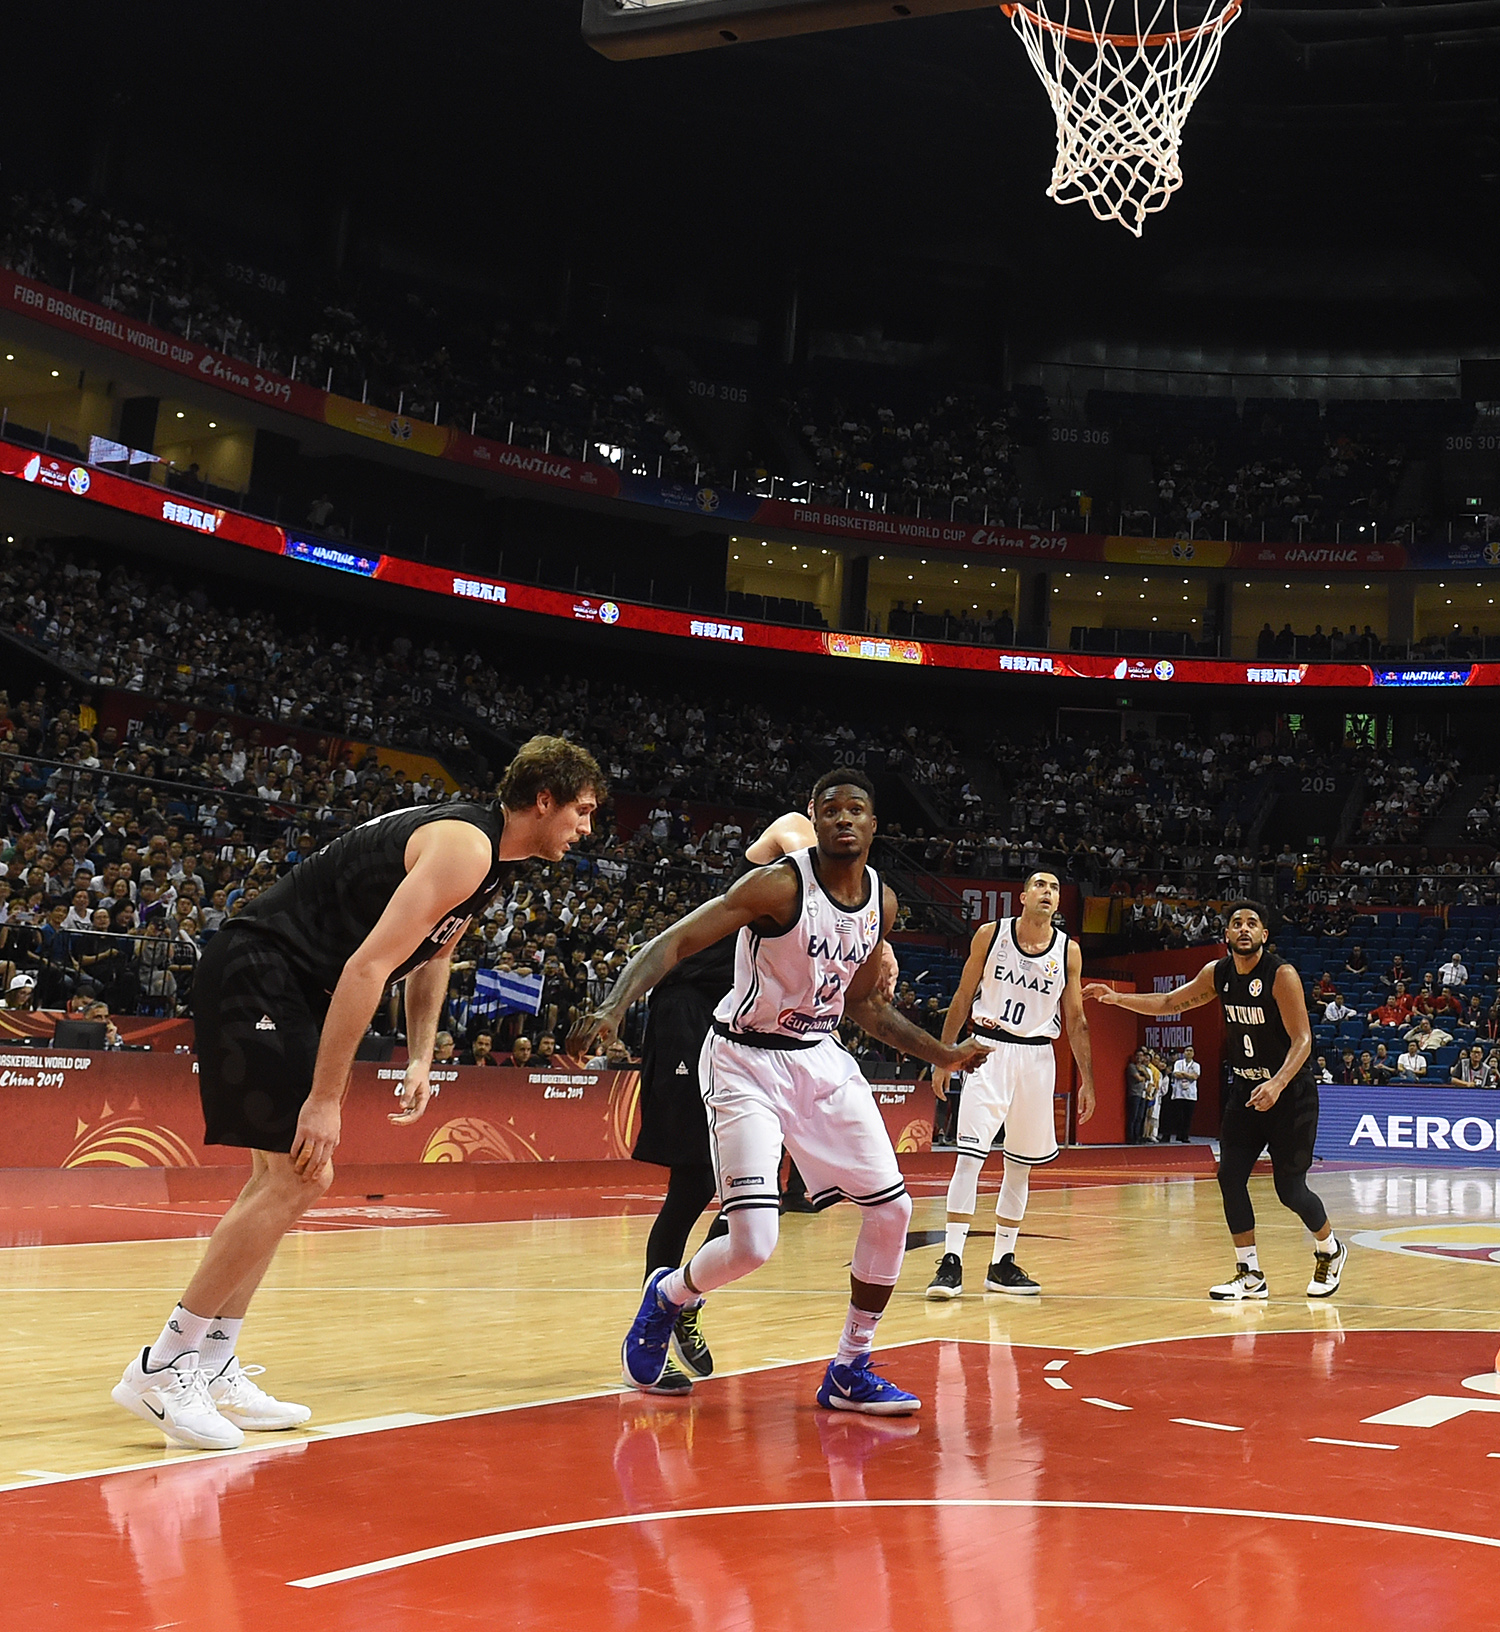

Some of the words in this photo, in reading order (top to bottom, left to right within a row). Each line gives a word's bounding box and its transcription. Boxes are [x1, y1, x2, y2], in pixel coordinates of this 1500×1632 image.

[13, 285, 44, 310] FIBA
[47, 297, 124, 340] BASKETBALL
[127, 328, 168, 357] WORLD
[171, 345, 194, 365] CUP
[199, 355, 250, 388] China
[254, 374, 292, 403] 2019
[688, 381, 716, 399] 304
[720, 386, 747, 404] 305
[1051, 427, 1078, 443] 305
[1082, 428, 1110, 445] 306
[1445, 436, 1474, 451] 306
[794, 509, 820, 524] FIBA
[823, 513, 897, 535] BASKETBALL
[899, 523, 940, 540] WORLD
[943, 528, 966, 542] CUP
[971, 529, 1024, 548] China
[1029, 534, 1068, 553] 2019
[453, 578, 506, 603] 有我不凡
[690, 620, 743, 641] 有我不凡
[860, 641, 891, 658] 南京
[1000, 655, 1053, 672] 有我不凡
[1247, 668, 1301, 682] 有我不凡
[1301, 776, 1335, 793] 205
[1221, 887, 1245, 902] 104
[1305, 889, 1327, 905] 105
[962, 889, 1012, 921] G11
[994, 965, 1054, 994] ΕΛΛΑΣ
[1000, 998, 1026, 1026] 10
[788, 1014, 834, 1031] Eurbank
[1145, 1027, 1159, 1047] THE
[1162, 1026, 1192, 1047] WORLD
[1243, 1034, 1254, 1058] 9
[45, 1056, 73, 1069] WORLD
[74, 1057, 91, 1069] CUP
[0, 1070, 34, 1087] China
[36, 1072, 65, 1088] 2019
